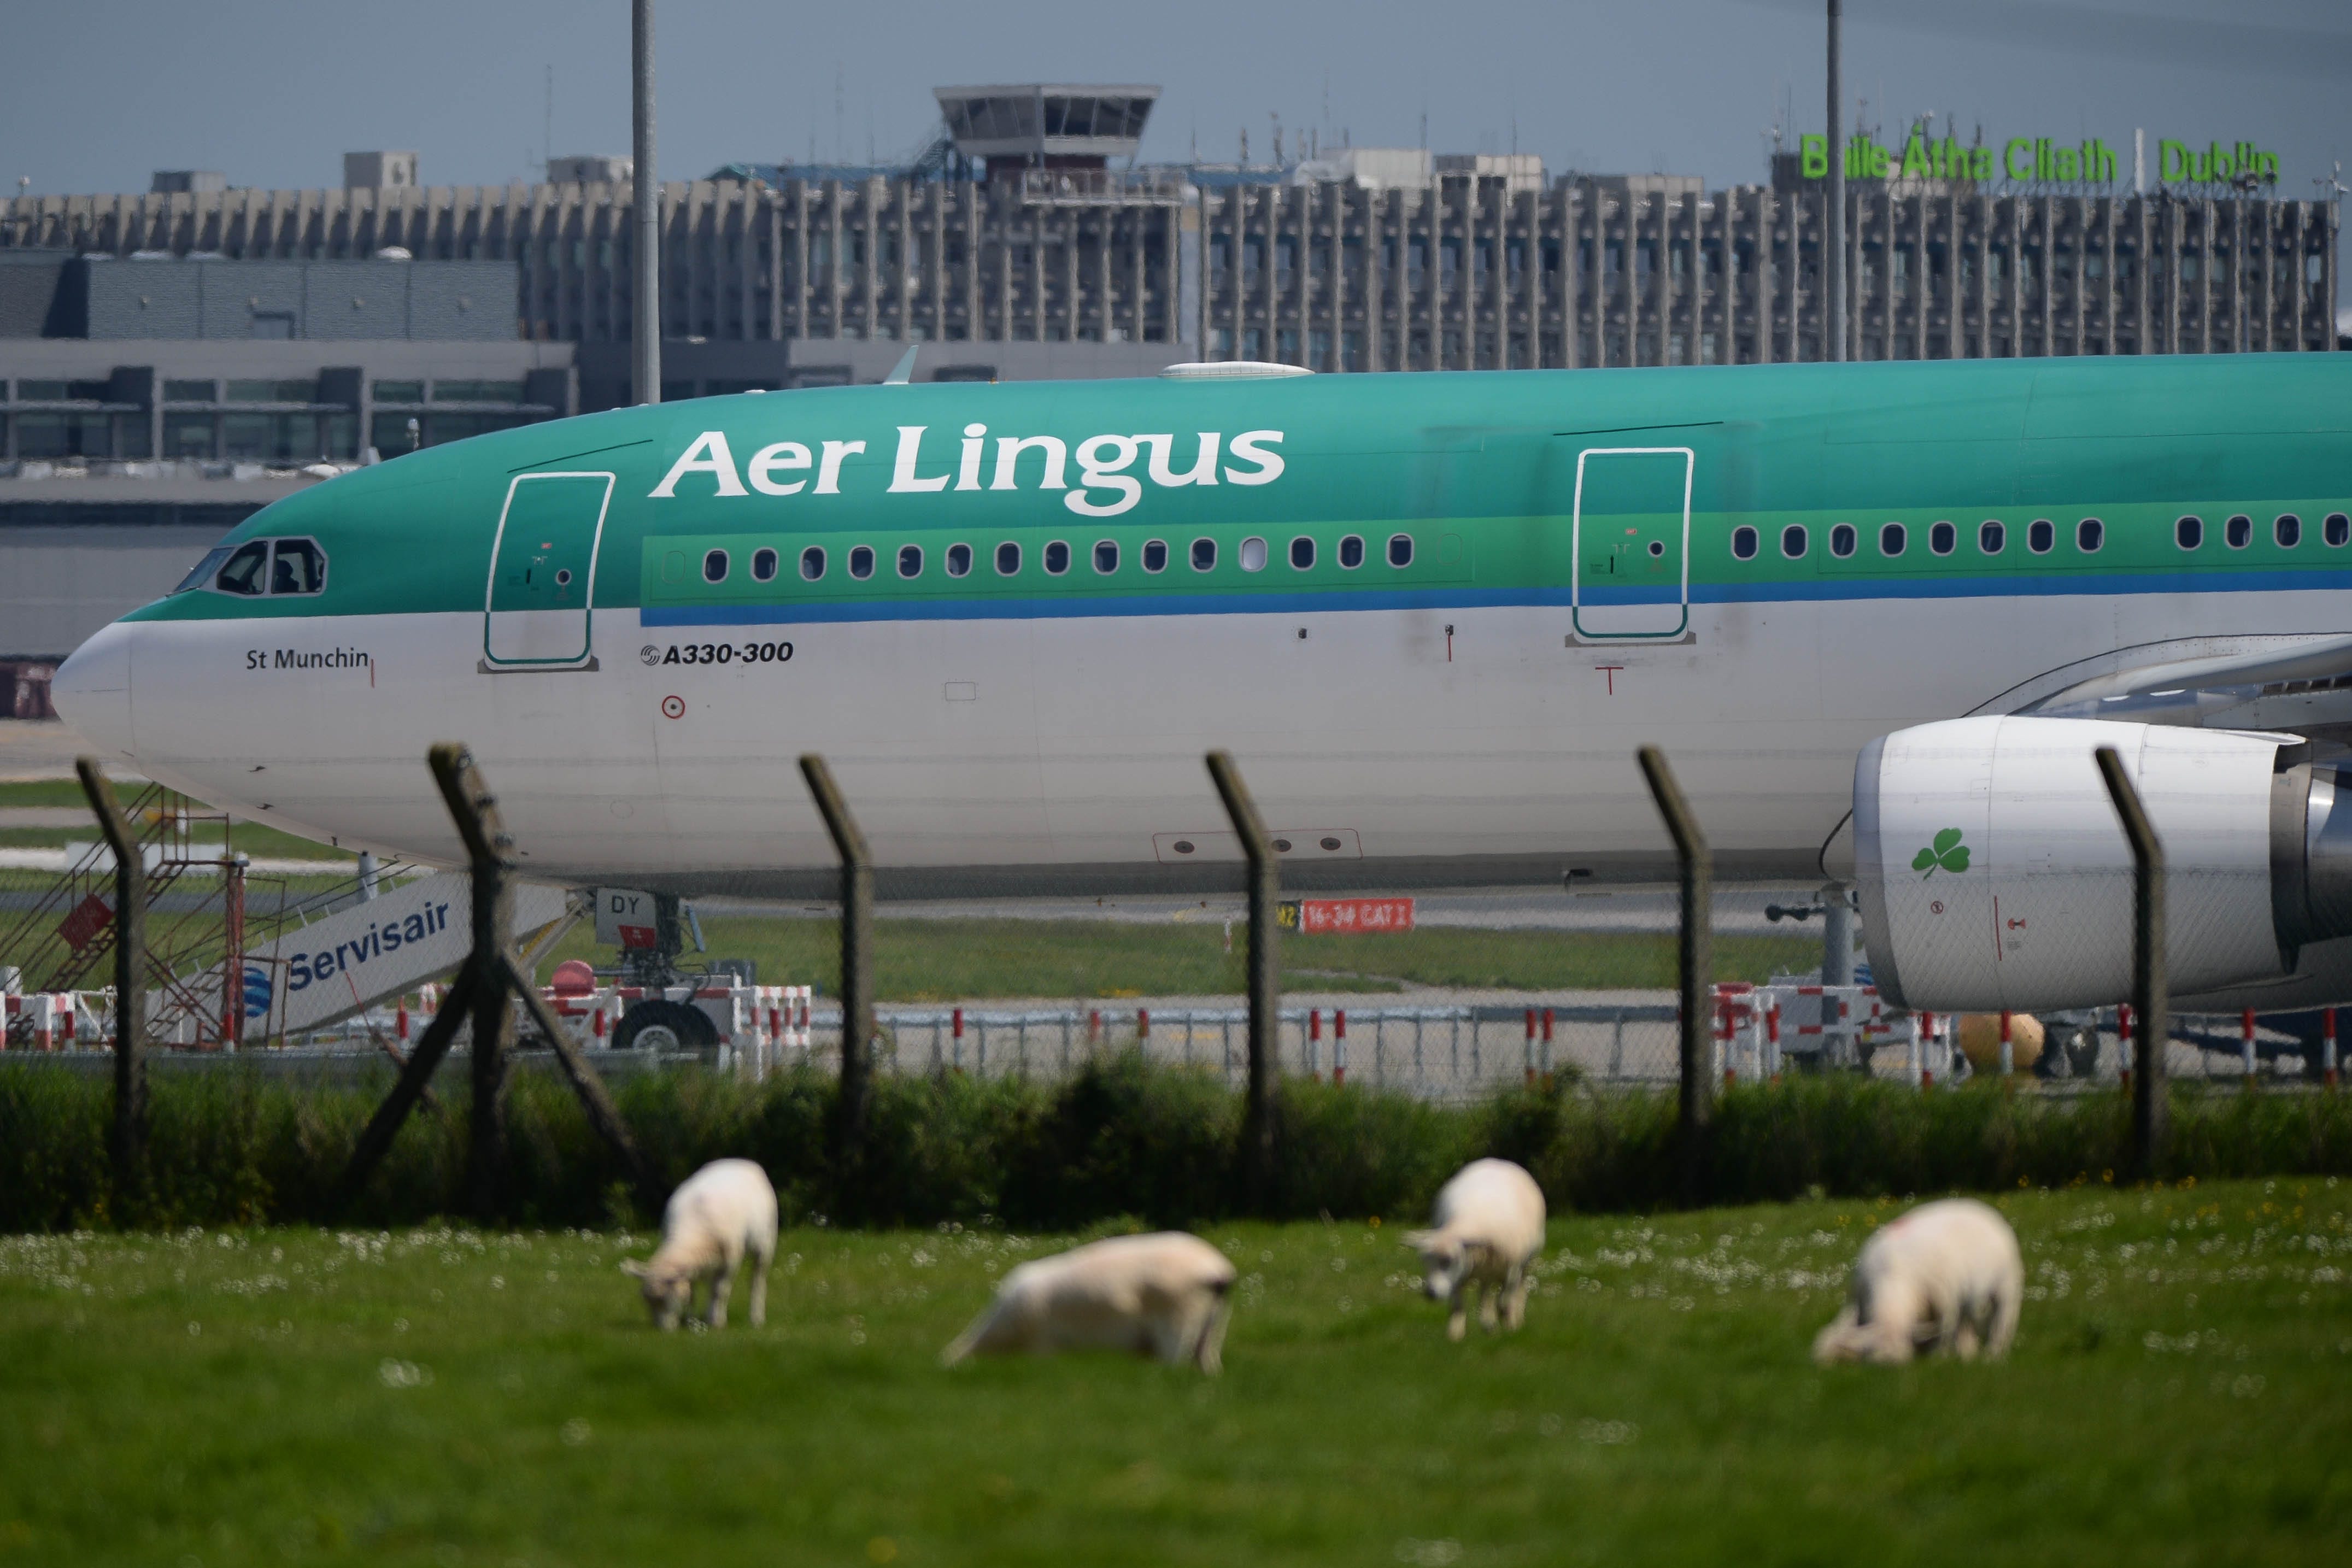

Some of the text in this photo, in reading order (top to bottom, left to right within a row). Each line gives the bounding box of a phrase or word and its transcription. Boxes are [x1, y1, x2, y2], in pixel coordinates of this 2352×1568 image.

[2007, 137, 2118, 181] Cliath
[2161, 139, 2280, 183] Dublin
[647, 422, 1284, 517] Aer Lingus
[247, 647, 368, 670] St Munchin
[662, 642, 794, 665] A330-300
[612, 895, 640, 914] DY
[288, 901, 449, 991] Servisair
